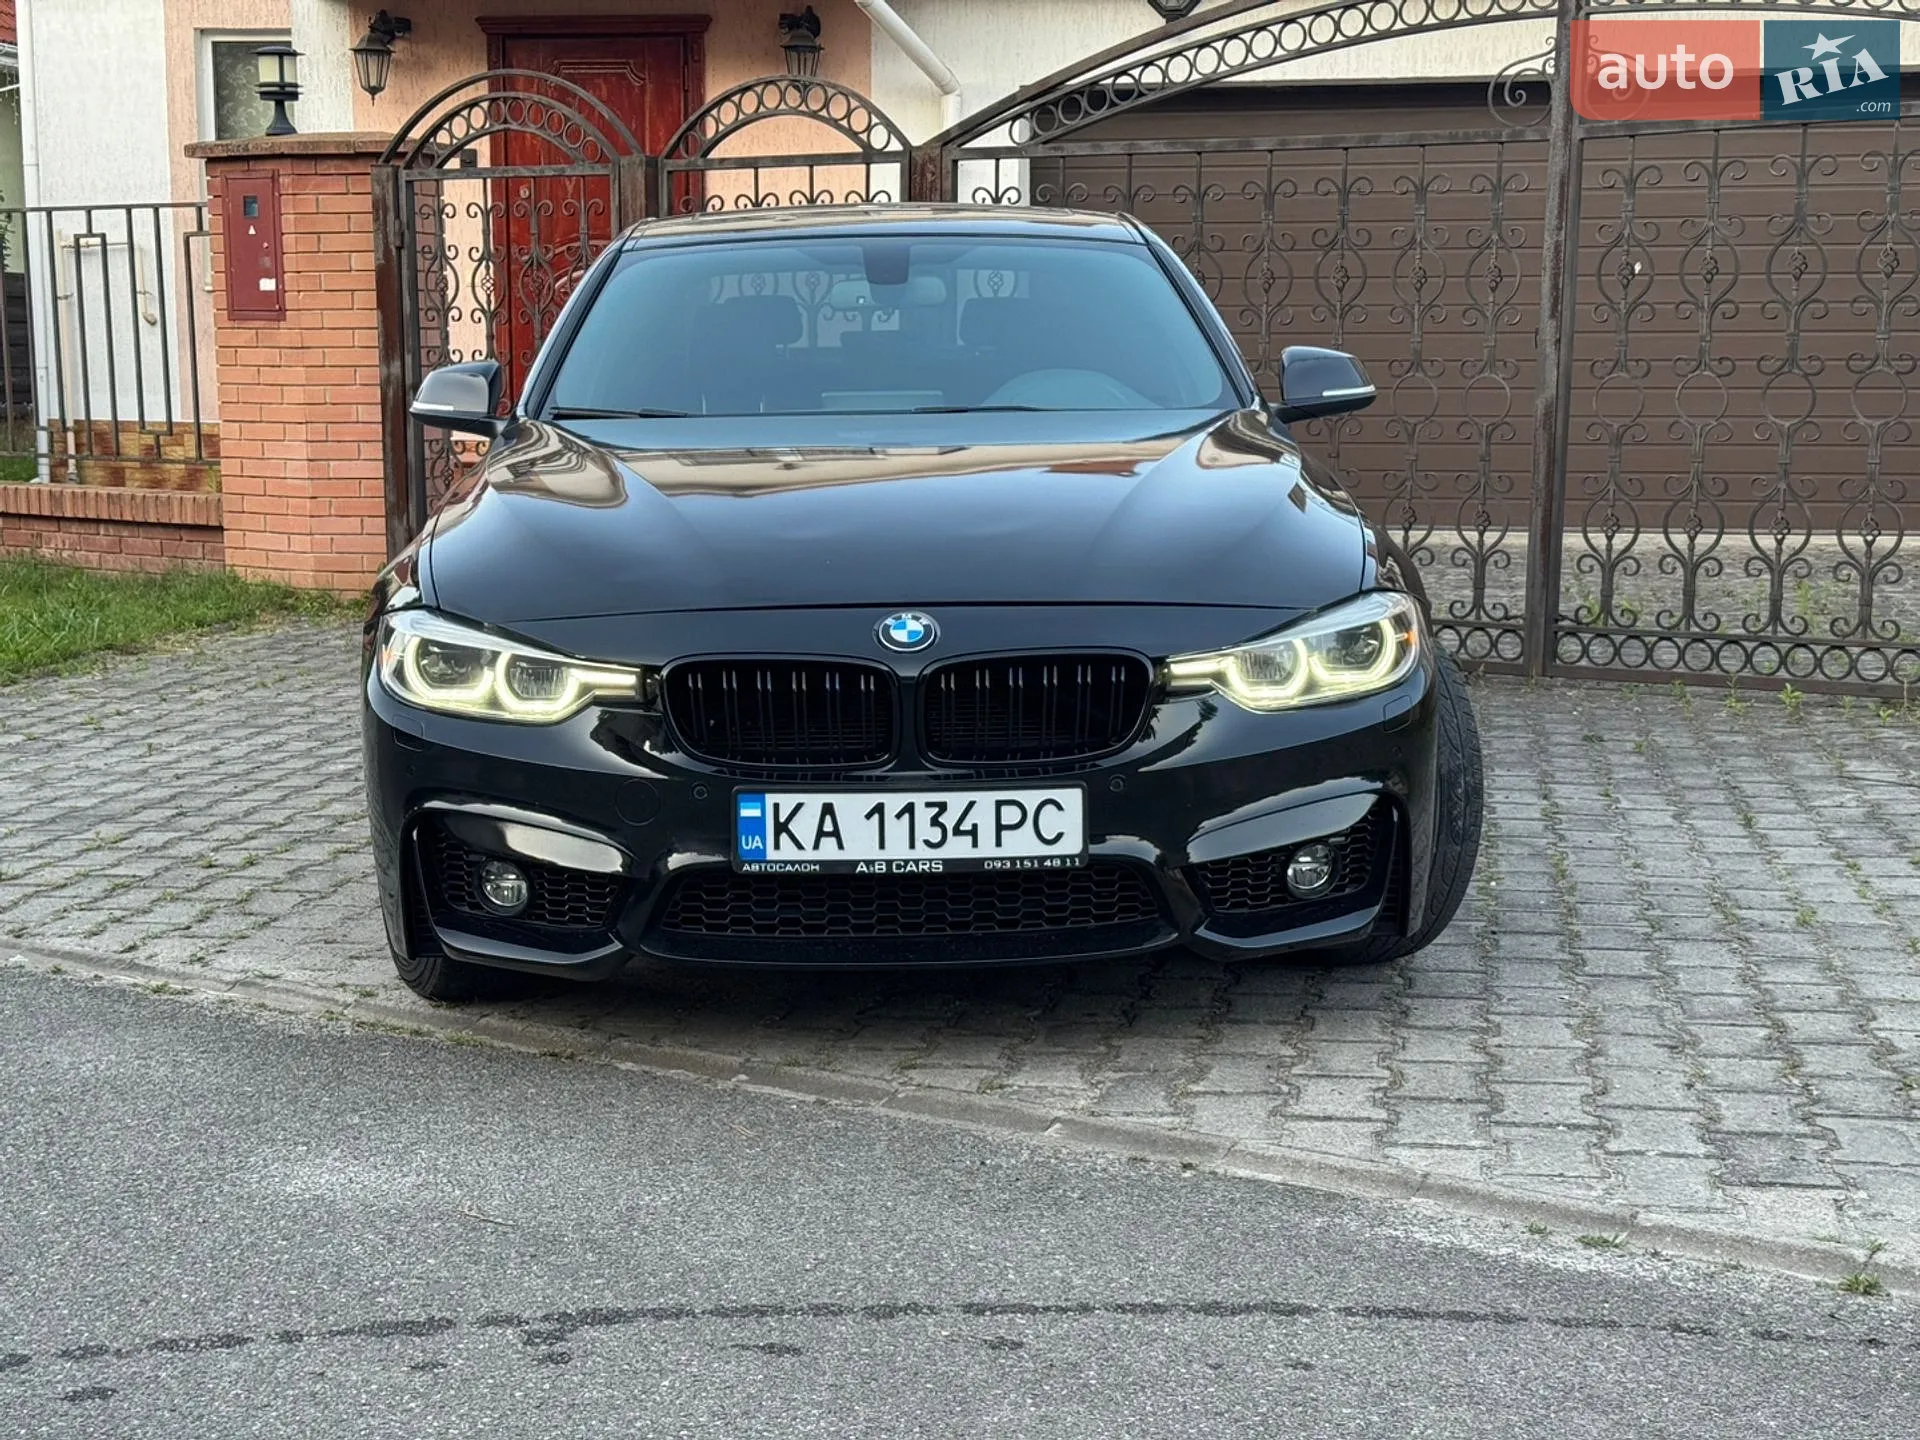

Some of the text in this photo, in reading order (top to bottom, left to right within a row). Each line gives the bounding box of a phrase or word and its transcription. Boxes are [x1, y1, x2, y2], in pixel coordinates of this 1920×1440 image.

[773, 798, 1065, 851] KA 1134 PC
[742, 835, 763, 850] UA
[742, 863, 820, 873] АВТОСАЛОН
[892, 860, 943, 873] CARS
[984, 860, 1011, 870] 093
[1015, 859, 1039, 869] 151
[1065, 857, 1080, 867] 11
